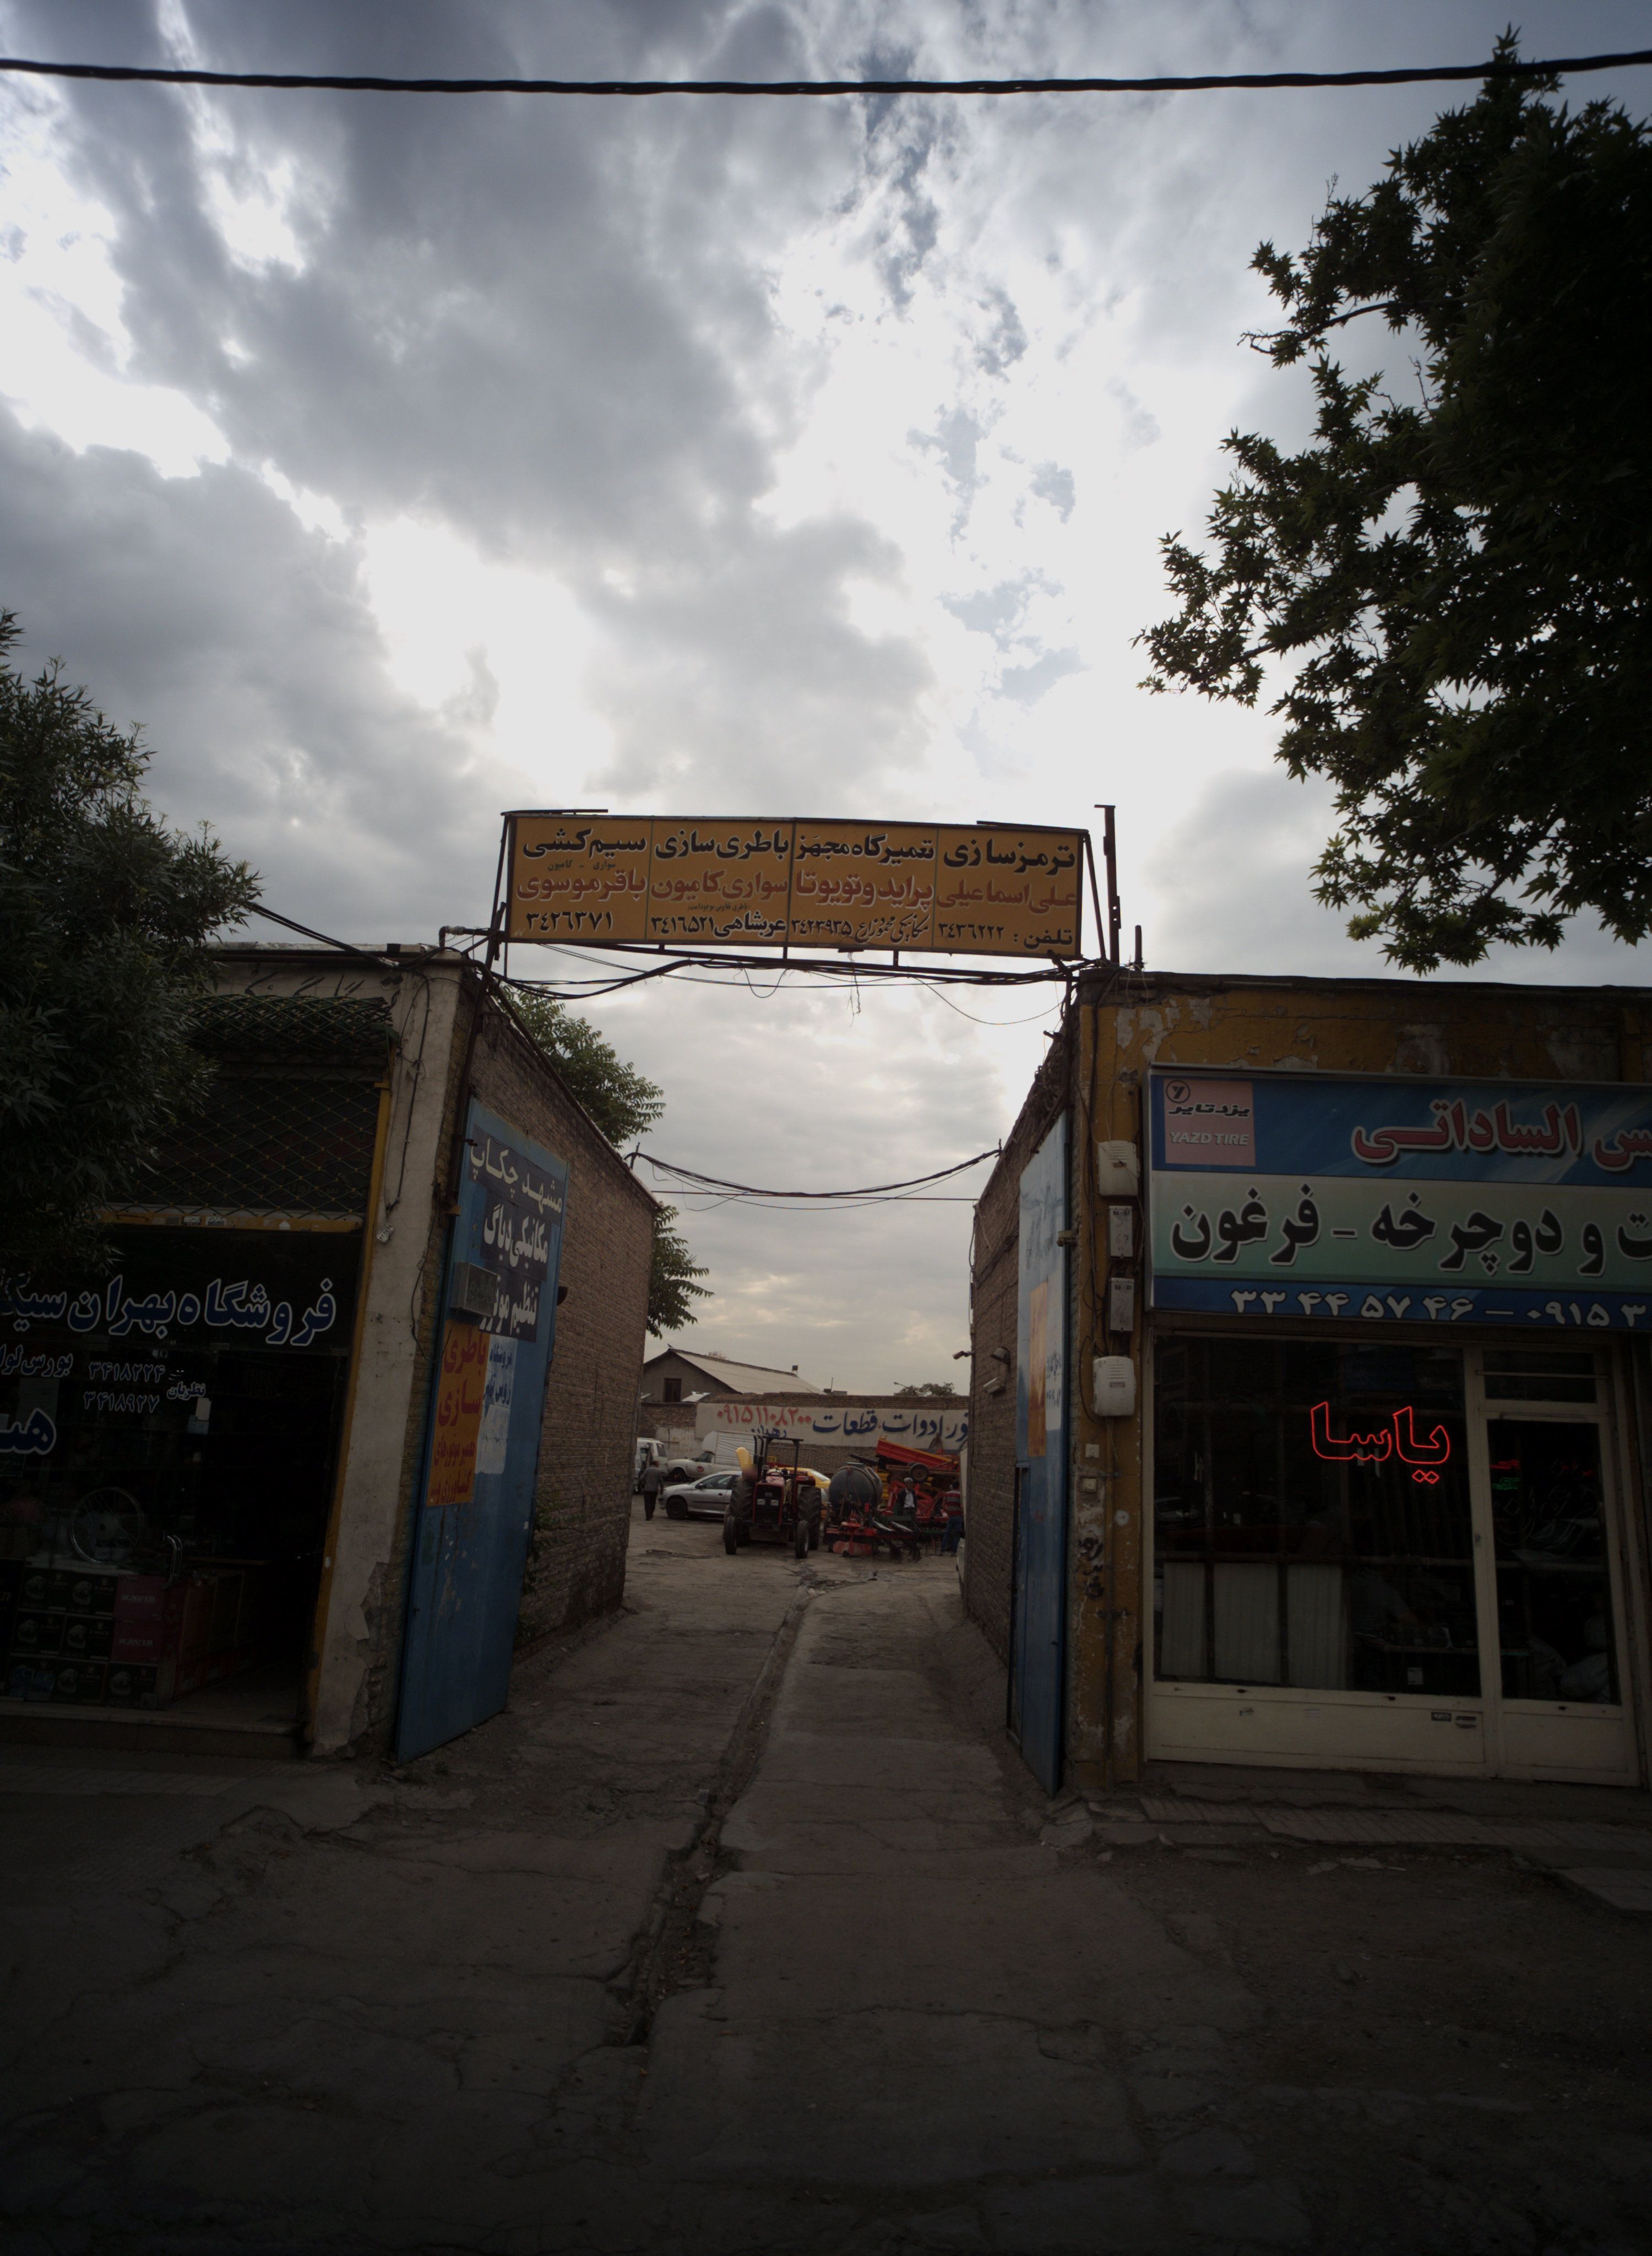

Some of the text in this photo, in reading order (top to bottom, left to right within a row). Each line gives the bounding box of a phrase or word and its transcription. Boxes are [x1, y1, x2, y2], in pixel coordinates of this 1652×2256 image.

[523, 828, 647, 859] سیم کشی
[655, 828, 789, 861] باطری سازی
[852, 833, 935, 865] تعمیرگاه
[516, 867, 648, 901] باقر موسوی
[721, 871, 788, 900] سواری
[879, 875, 934, 912] پراید
[936, 880, 1077, 914] علی اسماعیلی
[1168, 1103, 1251, 1119] یزد تایر
[1170, 1131, 1249, 1146] YAZD TIRE
[1350, 1098, 1583, 1163] الساداتی
[522, 1172, 562, 1214] مشهد
[1171, 1183, 1320, 1266] فرغون
[509, 1215, 548, 1270] مکانیکی
[177, 1277, 336, 1347] فروشگاه
[509, 1280, 539, 1336] تنظیم
[20, 1352, 74, 1378] بورس
[438, 1379, 482, 1427] سازی
[812, 1409, 878, 1435] قطعات
[882, 1413, 944, 1438] ادوات
[1311, 1401, 1450, 1484] یاسا
